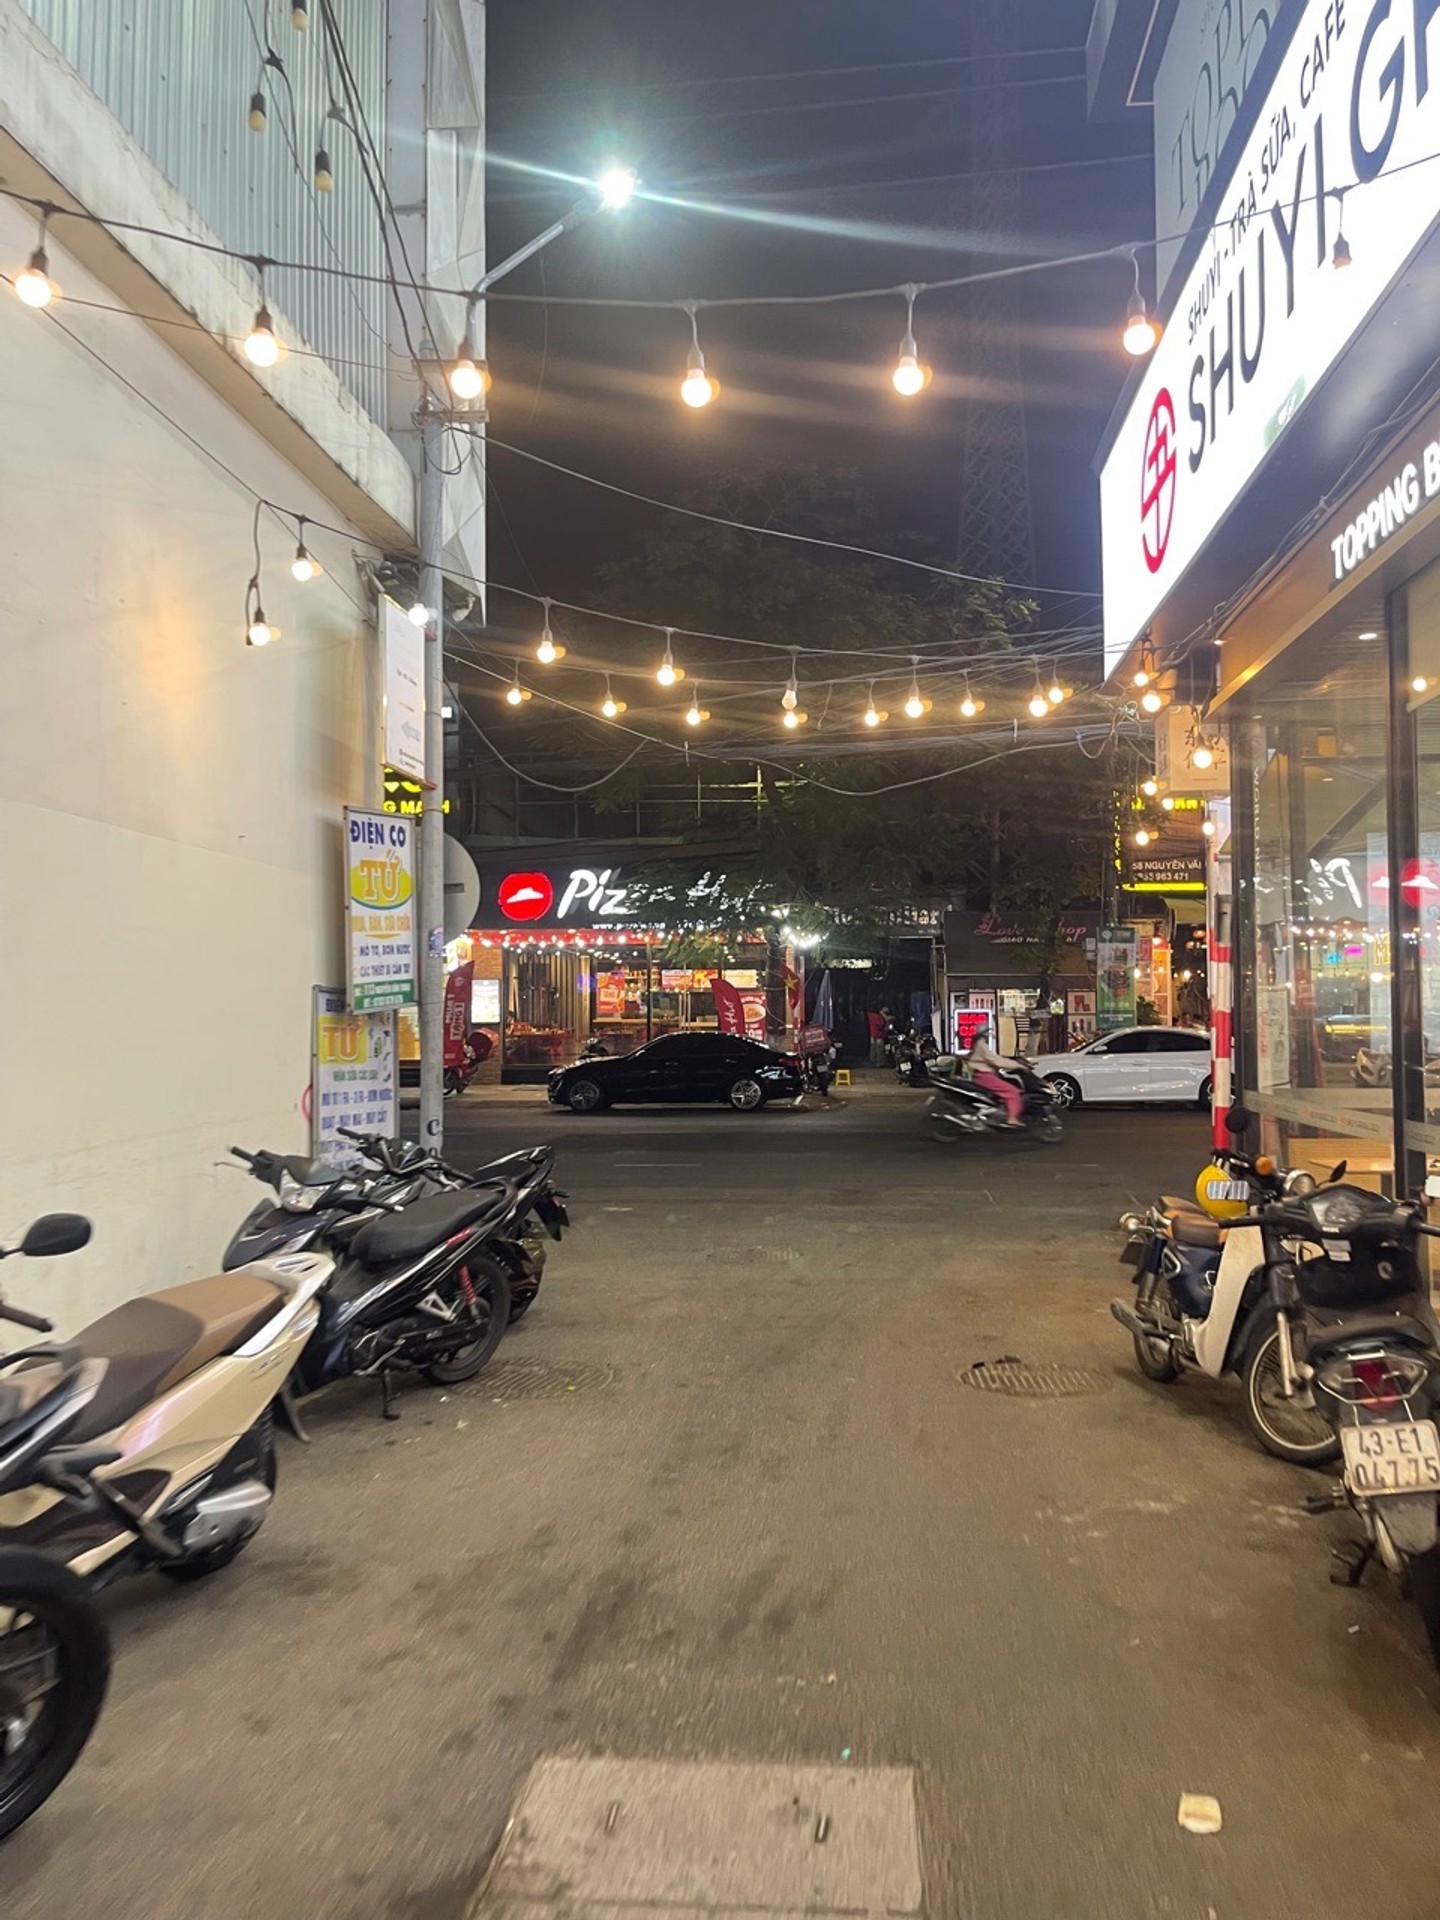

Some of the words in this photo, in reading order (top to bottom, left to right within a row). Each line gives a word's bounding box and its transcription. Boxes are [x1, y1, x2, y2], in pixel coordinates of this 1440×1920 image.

[1188, 112, 1326, 475] SHUYI
[1188, 250, 1221, 347] SHUYI
[1331, 462, 1420, 580] TOPPING
[1358, 1427, 1423, 1458] 43-E1
